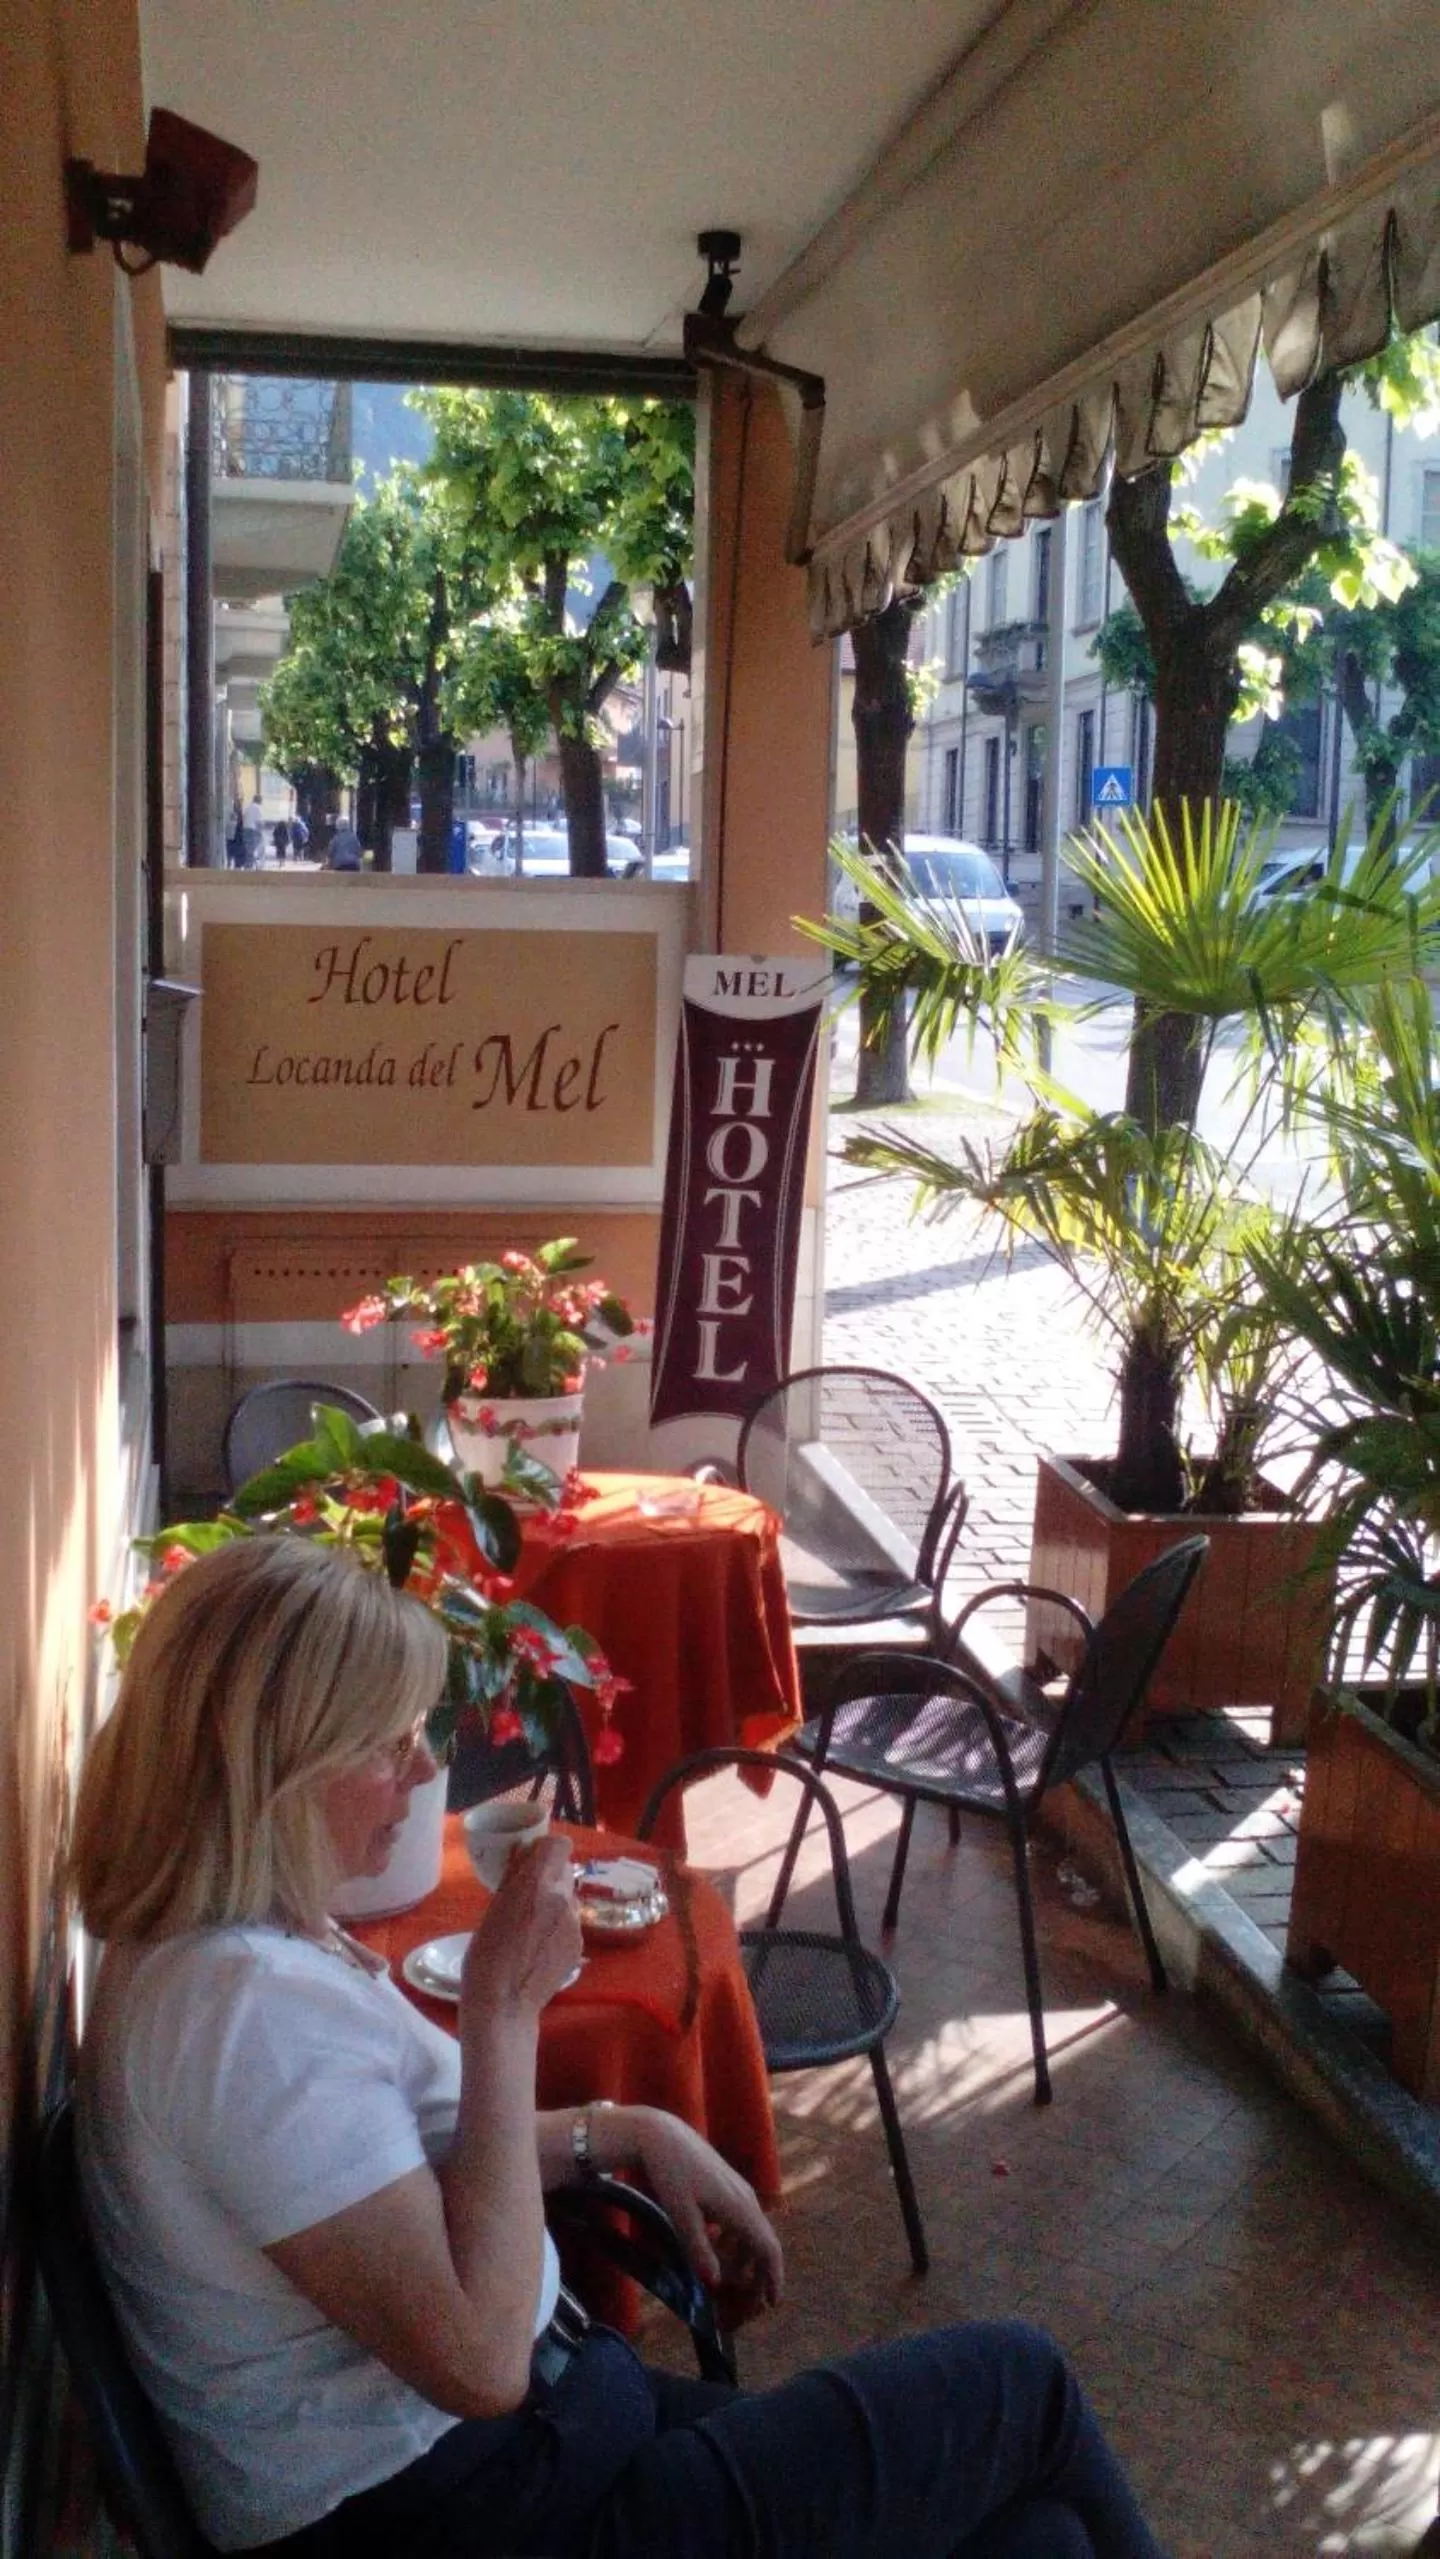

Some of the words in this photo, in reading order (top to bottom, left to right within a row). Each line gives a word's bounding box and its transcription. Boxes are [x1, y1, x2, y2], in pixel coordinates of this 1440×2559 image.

[307, 936, 464, 1005] Hotel
[711, 970, 798, 998] MEL
[246, 1042, 397, 1087] Locanda
[408, 1043, 465, 1088] del
[472, 1023, 620, 1113] Mel
[692, 1057, 776, 1383] HOTEL
